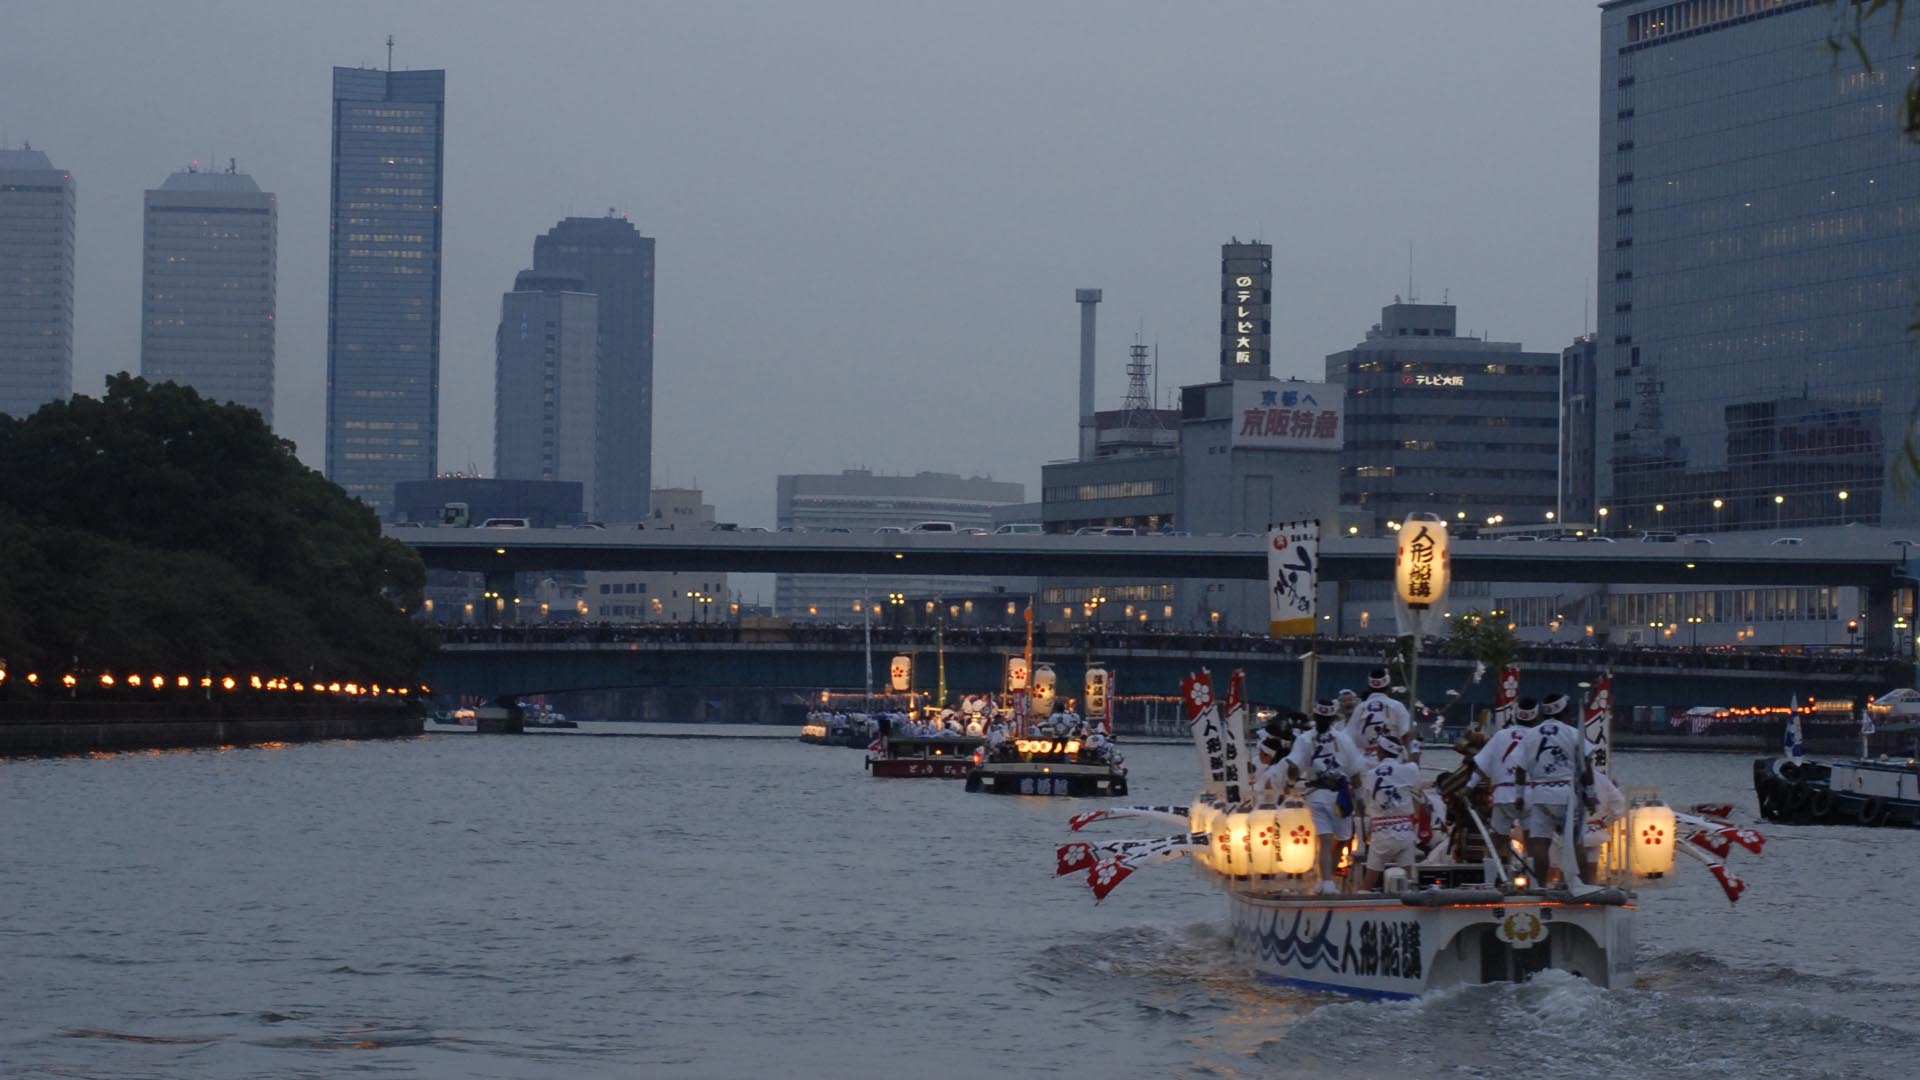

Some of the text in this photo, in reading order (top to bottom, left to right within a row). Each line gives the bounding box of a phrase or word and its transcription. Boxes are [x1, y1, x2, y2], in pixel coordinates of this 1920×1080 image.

[1416, 374, 1464, 386] テレビ大阪
[1261, 390, 1317, 407] 京都へ
[1240, 408, 1338, 439] 京阪特急
[1408, 526, 1435, 598] 人形船講
